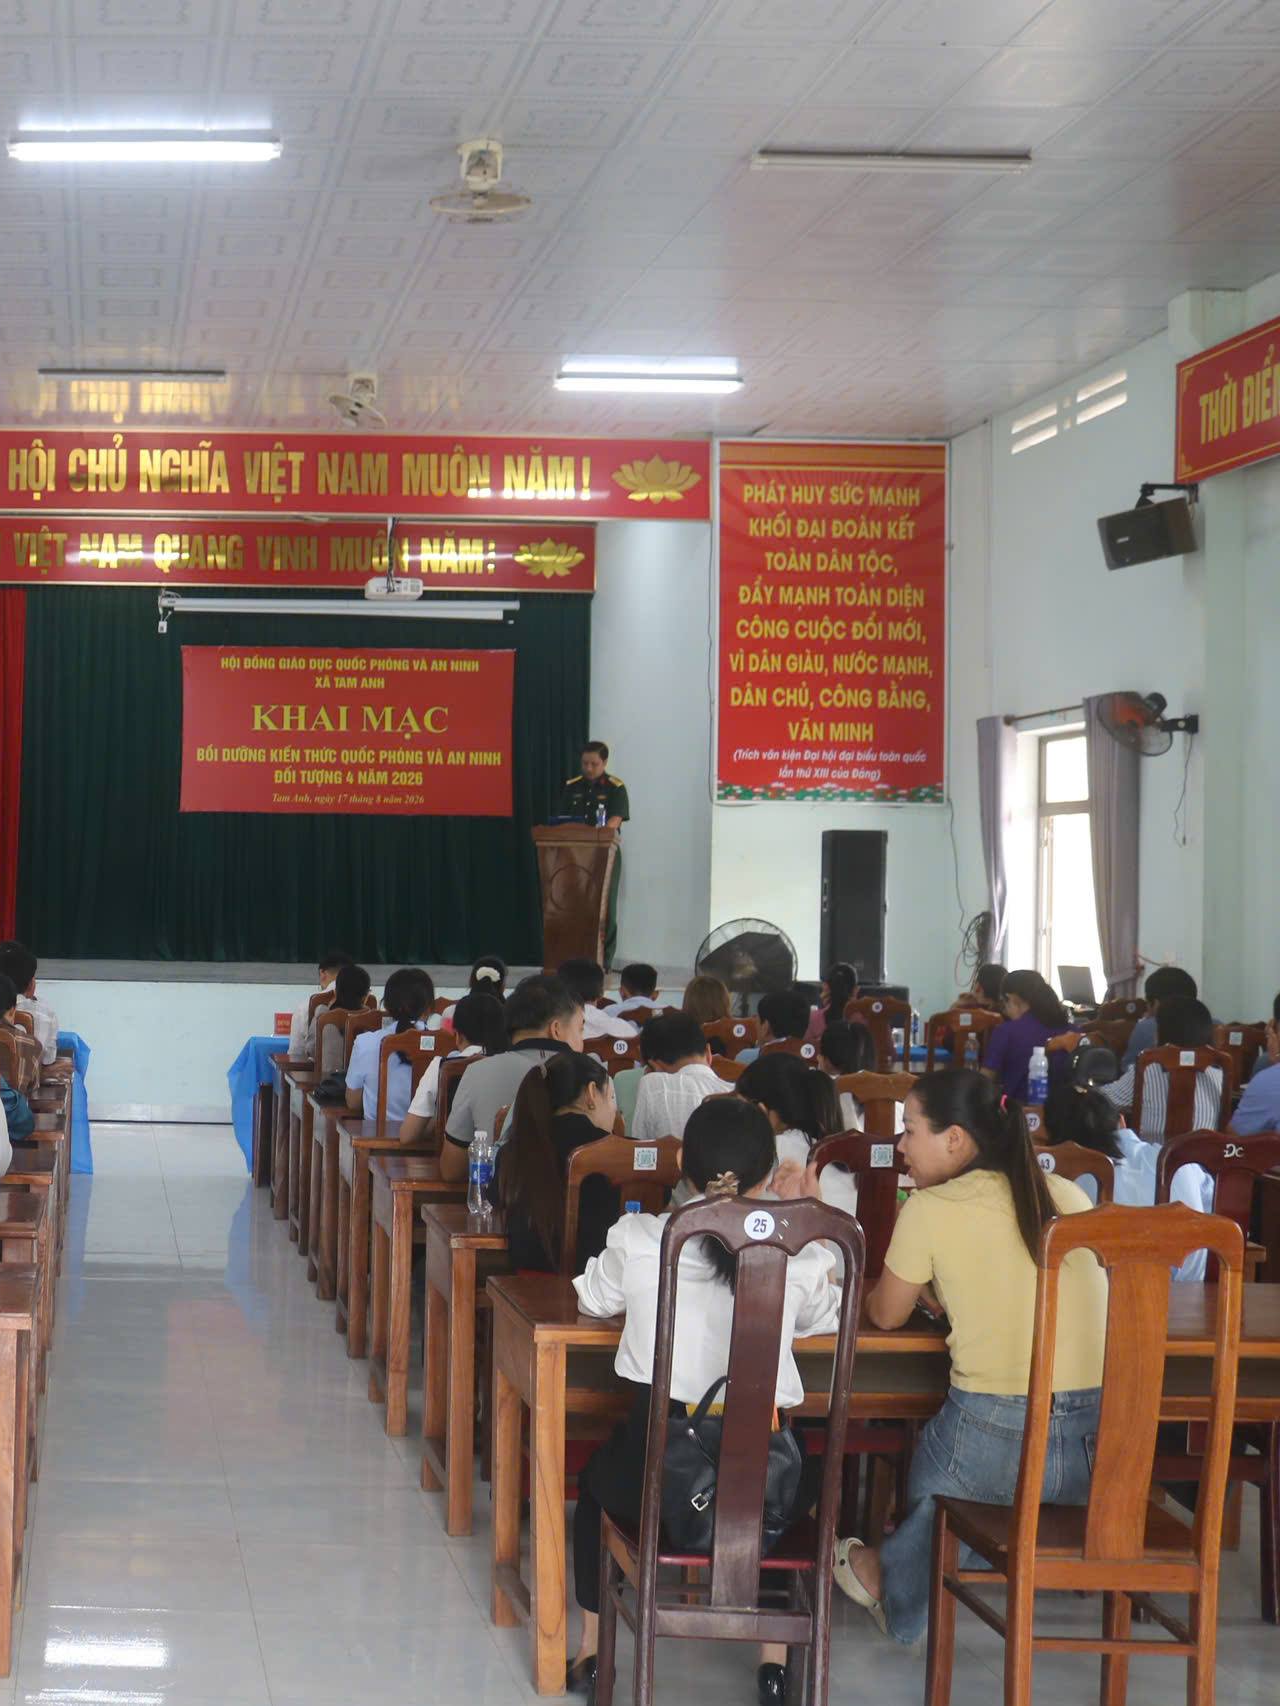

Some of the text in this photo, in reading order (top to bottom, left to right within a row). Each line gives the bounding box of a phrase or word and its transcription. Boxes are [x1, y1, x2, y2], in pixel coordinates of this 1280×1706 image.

[1199, 371, 1238, 445] THỜI
[8, 438, 56, 500] HỘI
[67, 433, 126, 492] CHỦ
[139, 440, 230, 494] NGHĨA
[243, 442, 305, 503] VIỆT
[318, 452, 389, 496] NAM
[402, 444, 491, 498] MUÔN
[743, 480, 920, 511] PHÁT HUY SỨC MẠNH
[749, 511, 916, 543] KHỐI ĐẠI ĐOÀN KẾT
[14, 525, 68, 575] VIỆT
[79, 532, 142, 569] NAM
[154, 532, 245, 573] QUANG
[257, 536, 317, 571] VINH
[330, 530, 409, 575] MUÔN
[765, 548, 898, 578] TOÀN DÂN TỘC,
[739, 575, 924, 613] ĐẨY MẠNH TOÀN DIỆN
[736, 610, 926, 645] CÔNG CUỘC ĐỔI MỚI,
[729, 648, 933, 680] VÌ DÂN GIÀU, NƯỚC MẠNH,
[334, 677, 357, 688] TAM
[361, 677, 385, 689] ANH
[730, 680, 931, 712] DÂN CHỦ, CÔNG BẰNG,
[252, 704, 448, 740] KHAI MẠC
[788, 718, 874, 742] VĂN MINH
[222, 746, 266, 762] DƯỠNG
[270, 745, 300, 762] KIẾN
[304, 746, 337, 763] THỨC
[341, 745, 375, 764] QUỐC
[427, 747, 443, 765] VÀ
[447, 751, 465, 765] AN
[469, 751, 501, 766] NINH
[274, 765, 424, 787] ĐỐI TƯỢNG 4 NĂM 2026
[752, 1218, 767, 1233] 25
